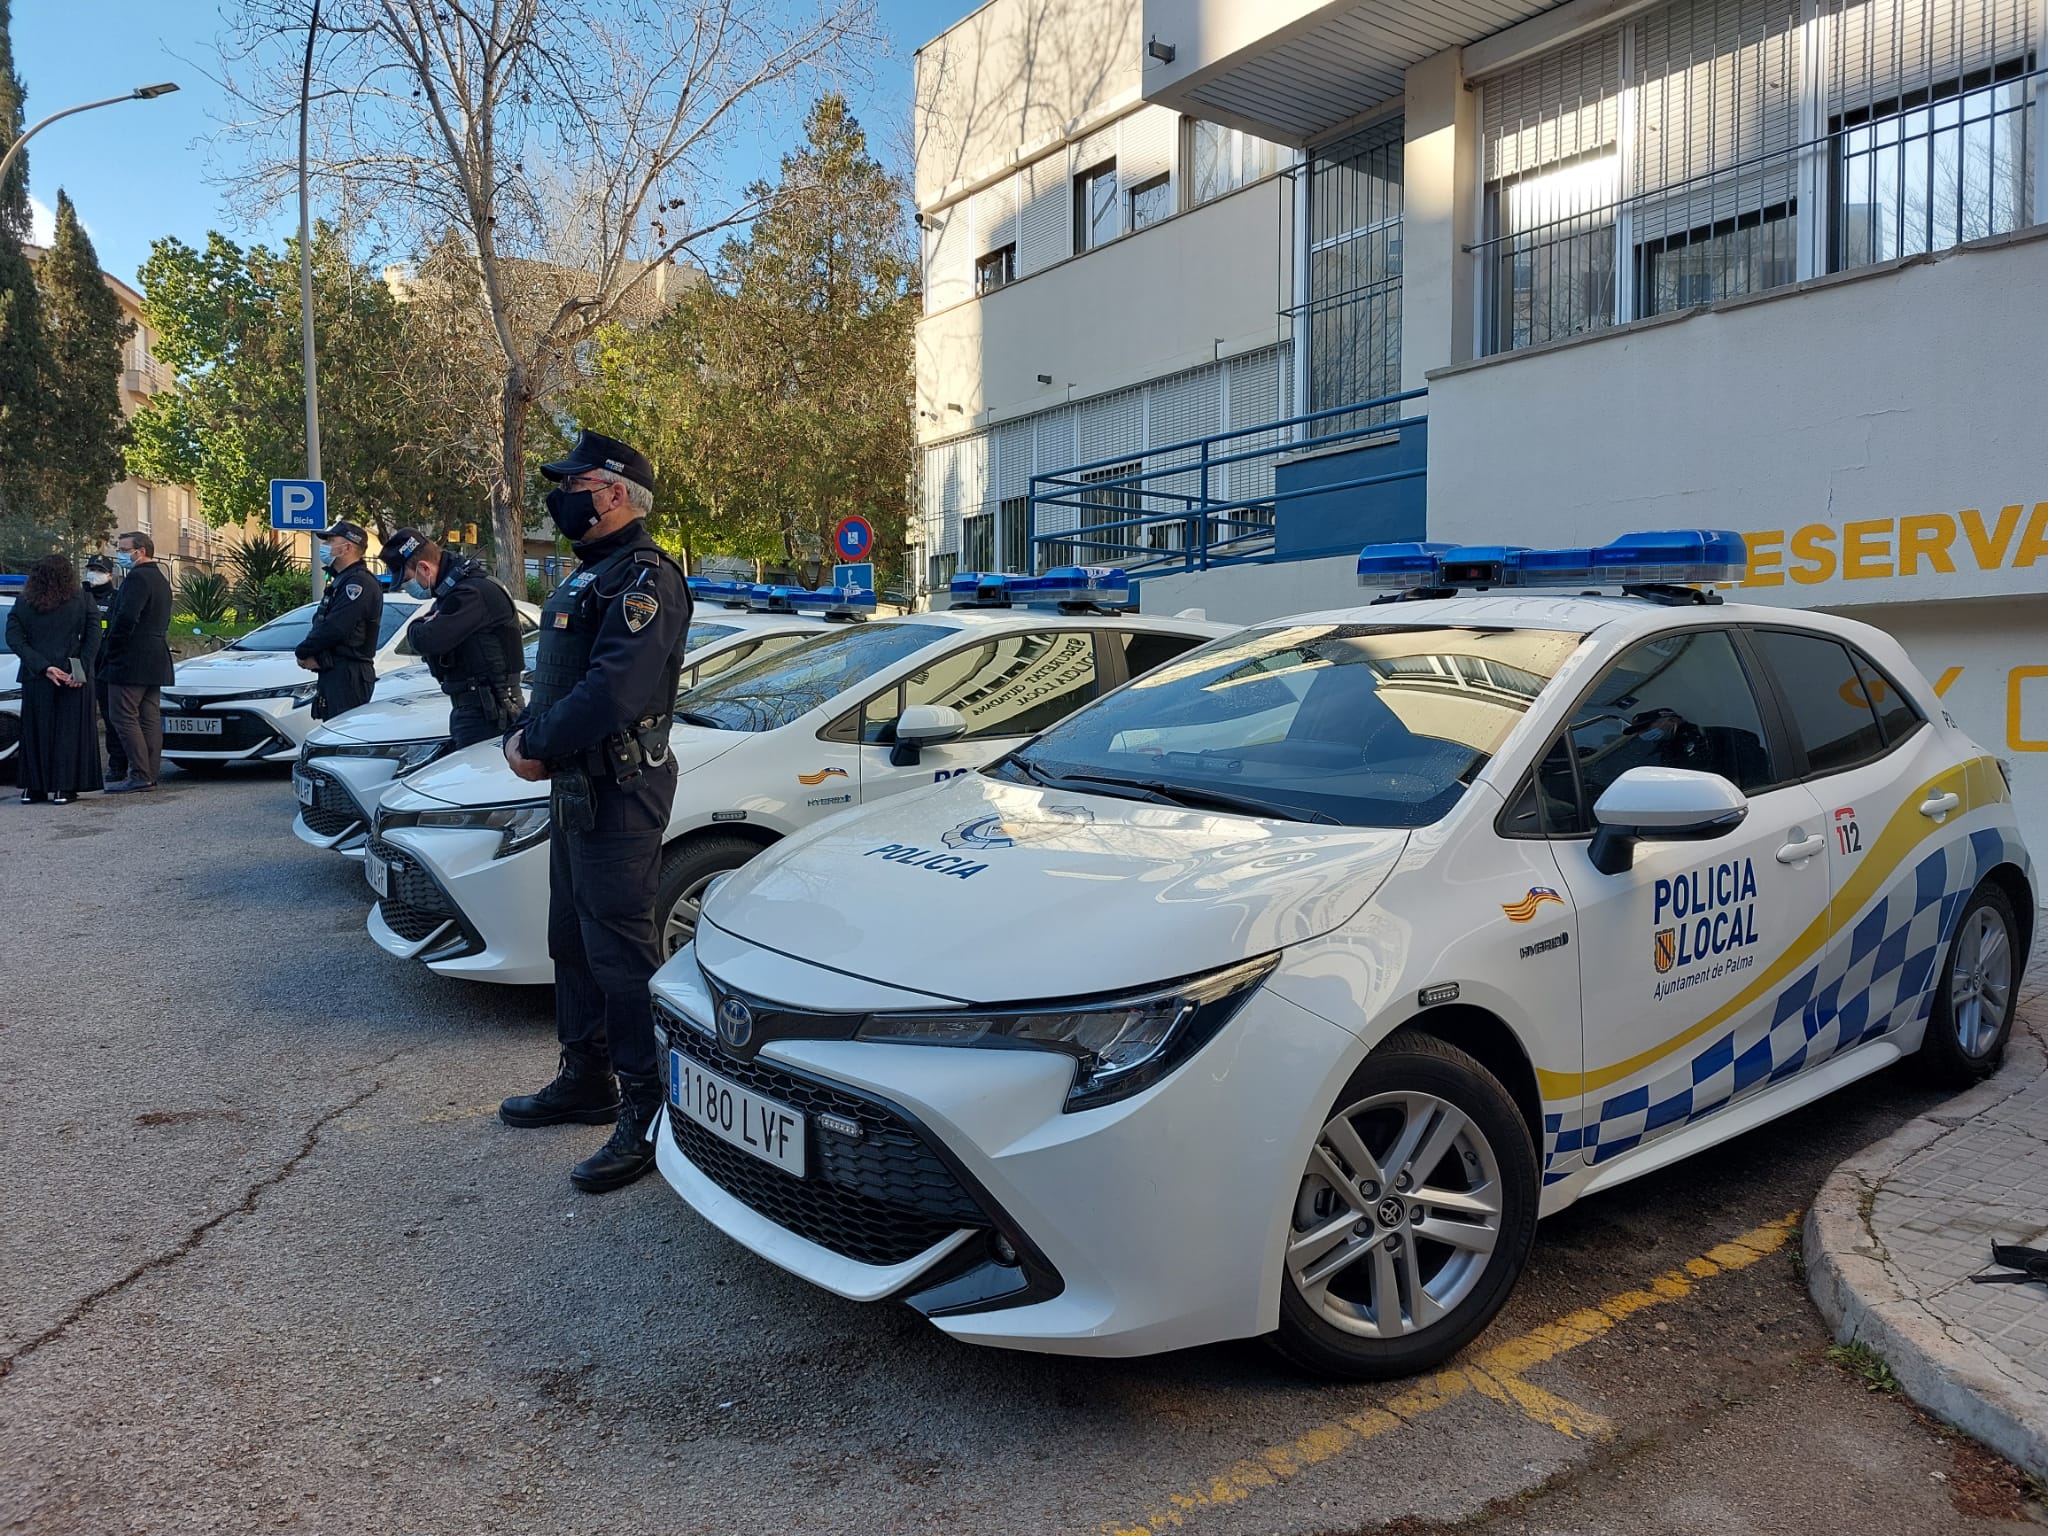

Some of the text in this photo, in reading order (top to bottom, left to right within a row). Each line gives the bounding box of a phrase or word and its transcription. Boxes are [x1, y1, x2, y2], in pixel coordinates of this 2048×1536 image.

[282, 486, 314, 524] P
[294, 516, 314, 525] Bicis
[1687, 502, 2048, 588] ESERVA
[168, 719, 218, 732] 1165 LVF
[1836, 821, 1862, 855] 112
[863, 844, 989, 880] POLICIA
[1654, 857, 1757, 925] POLICIA
[1677, 903, 1759, 967] LOCAL
[1653, 955, 1754, 1001] Ajuntament de Palma
[684, 1067, 794, 1159] 1180 LVF
